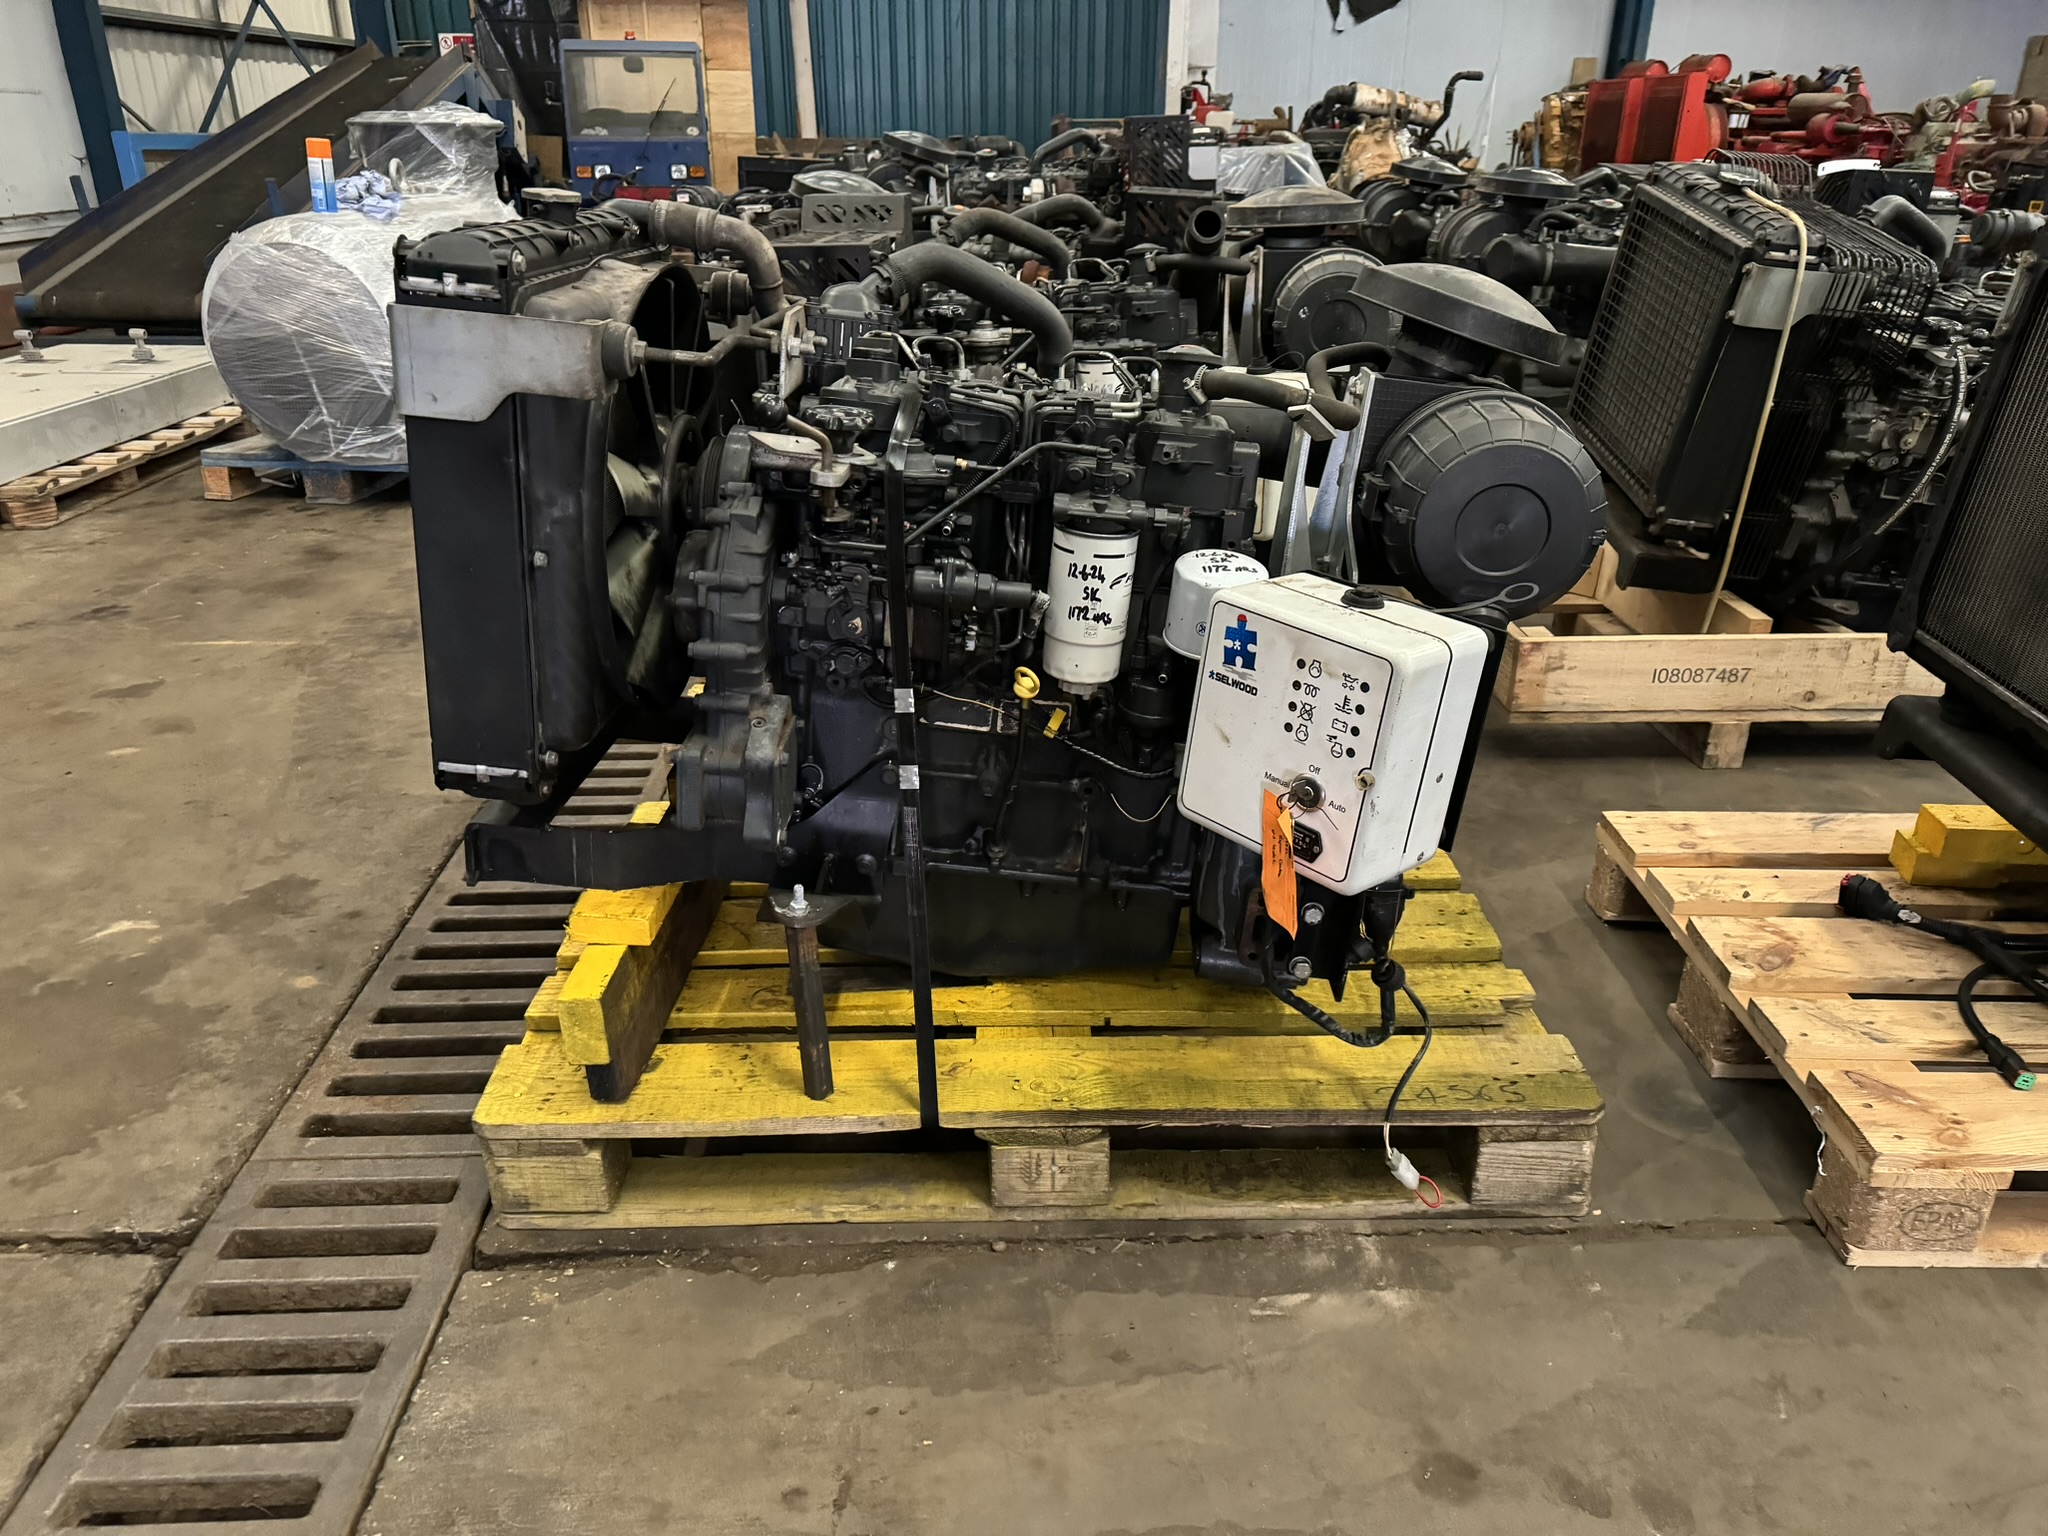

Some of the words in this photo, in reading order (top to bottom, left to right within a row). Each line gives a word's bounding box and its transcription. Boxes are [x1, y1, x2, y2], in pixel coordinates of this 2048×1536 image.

[1202, 564, 1231, 574] 1172
[1082, 585, 1103, 603] SK
[1068, 605, 1090, 621] 1172
[1215, 671, 1258, 697] SELWOOD
[1308, 763, 1321, 775] Off
[1264, 771, 1290, 790] Manual
[1328, 800, 1347, 814] Auto
